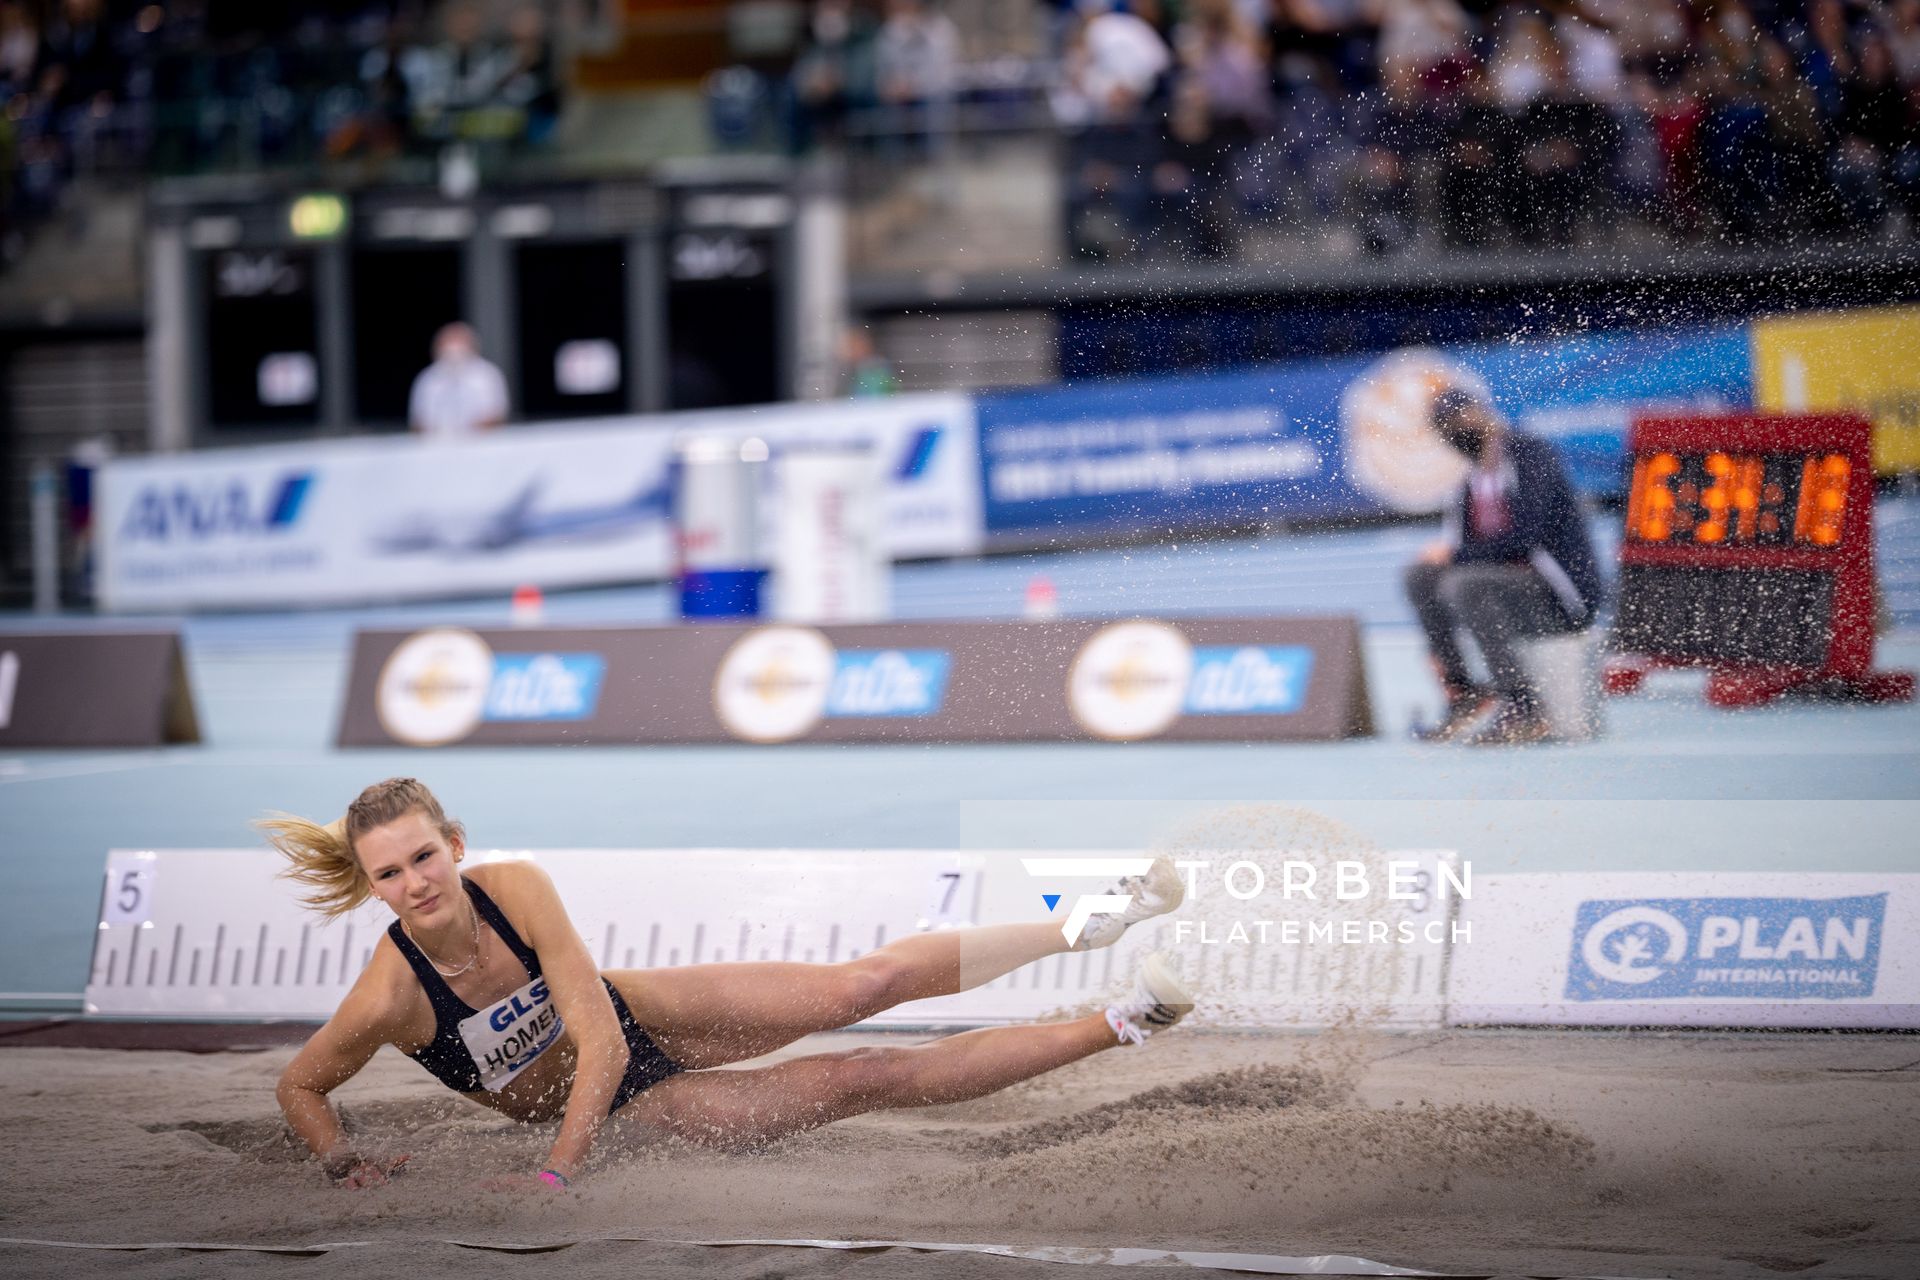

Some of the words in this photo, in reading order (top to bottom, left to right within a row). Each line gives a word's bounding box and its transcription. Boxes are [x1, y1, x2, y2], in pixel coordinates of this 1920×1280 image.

[118, 871, 141, 913] 5
[939, 872, 961, 914] 7
[1698, 917, 1871, 960] PLAN
[1695, 967, 1862, 985] INTERNATIONAL
[489, 980, 550, 1032] GLS
